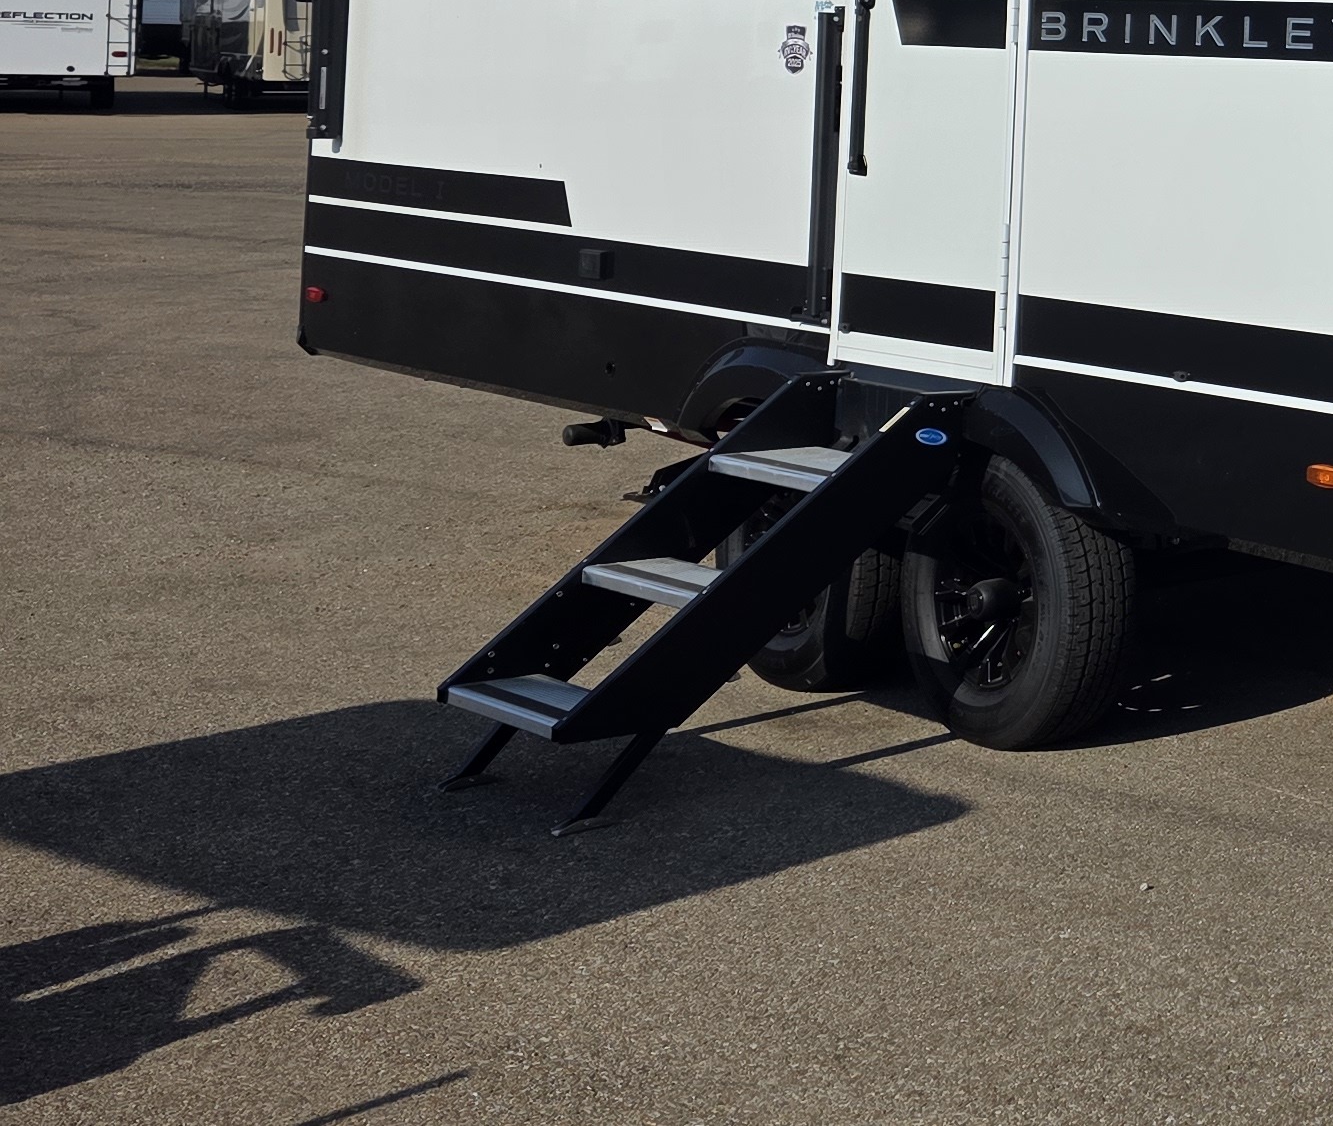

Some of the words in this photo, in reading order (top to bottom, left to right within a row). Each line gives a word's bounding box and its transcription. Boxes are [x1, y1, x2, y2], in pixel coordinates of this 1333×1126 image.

[0, 11, 94, 21] EFLECTION
[787, 58, 802, 67] 2025
[344, 172, 421, 196] MODEL
